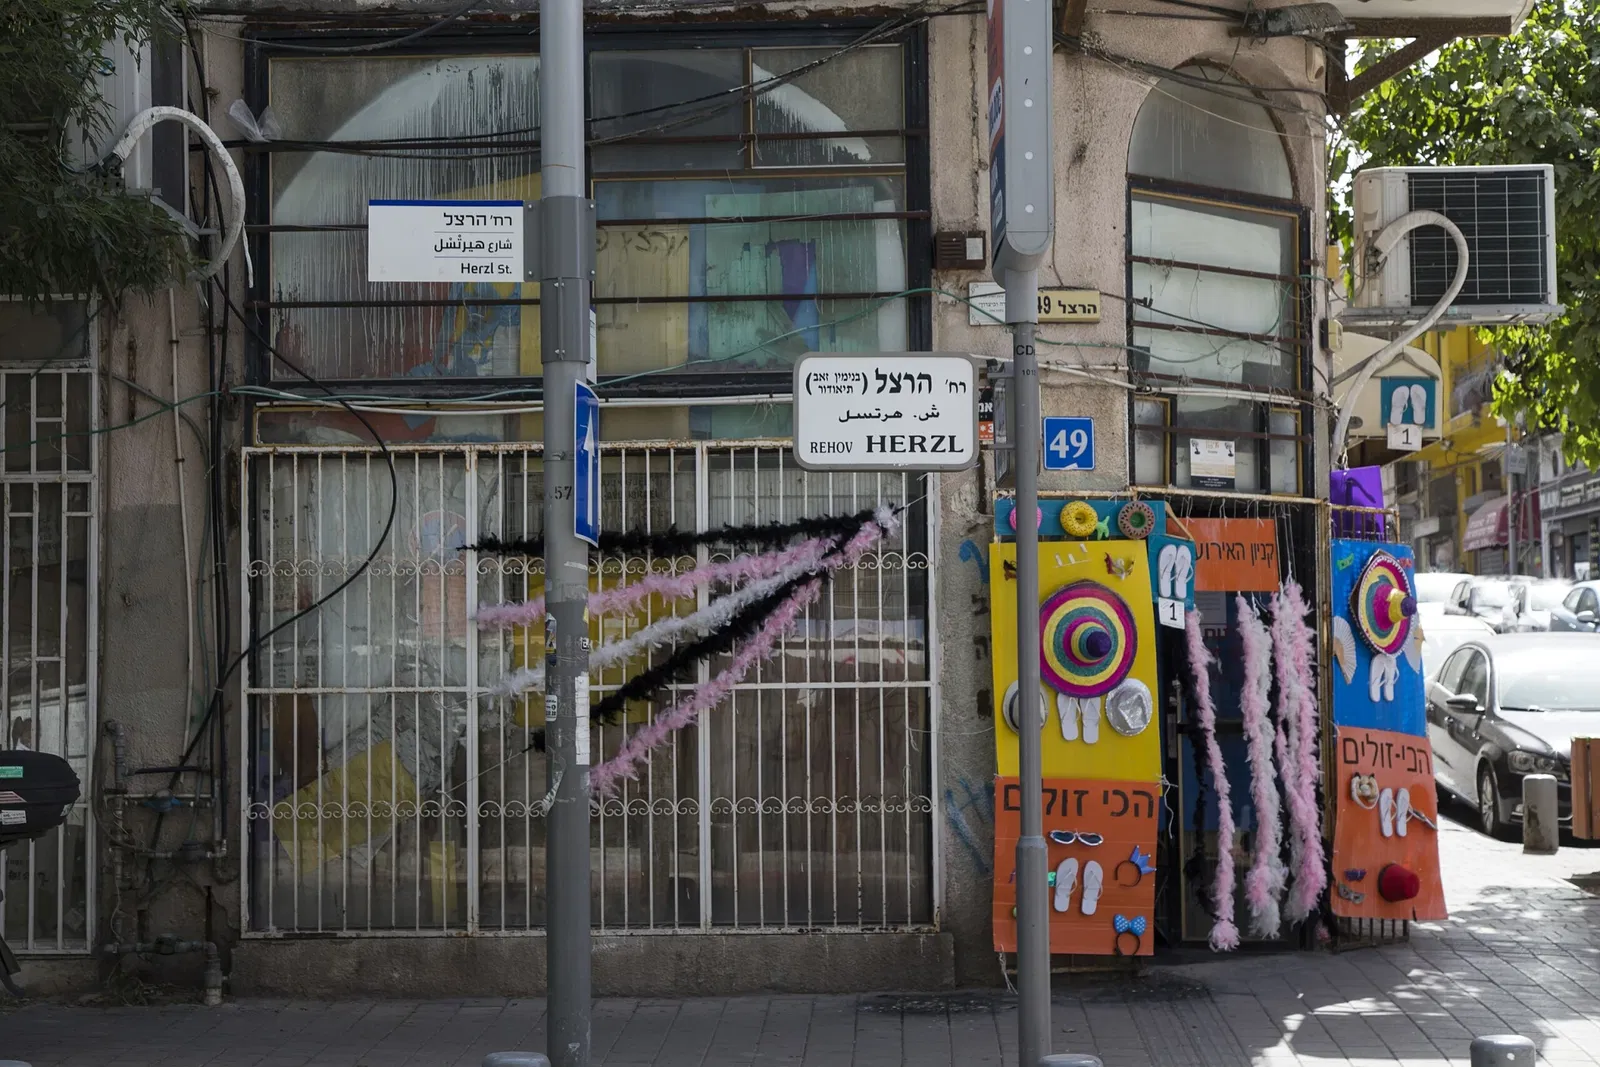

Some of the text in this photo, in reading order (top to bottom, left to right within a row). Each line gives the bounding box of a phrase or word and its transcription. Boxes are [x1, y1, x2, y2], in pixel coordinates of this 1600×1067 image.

[443, 212, 512, 226] רח' הרצל
[487, 239, 512, 253] شارع
[460, 262, 512, 274] Herzl St.
[1057, 300, 1098, 314] הרצל
[874, 367, 933, 395] הרצל
[944, 379, 967, 394] רח'
[838, 408, 903, 423] هرتسل
[810, 435, 964, 454] REHOV HERZL
[1049, 429, 1088, 459] 49
[1402, 428, 1412, 445] 1
[1250, 543, 1275, 568] קניון
[1169, 602, 1177, 621] 1
[1003, 778, 1155, 819] הכי זולם
